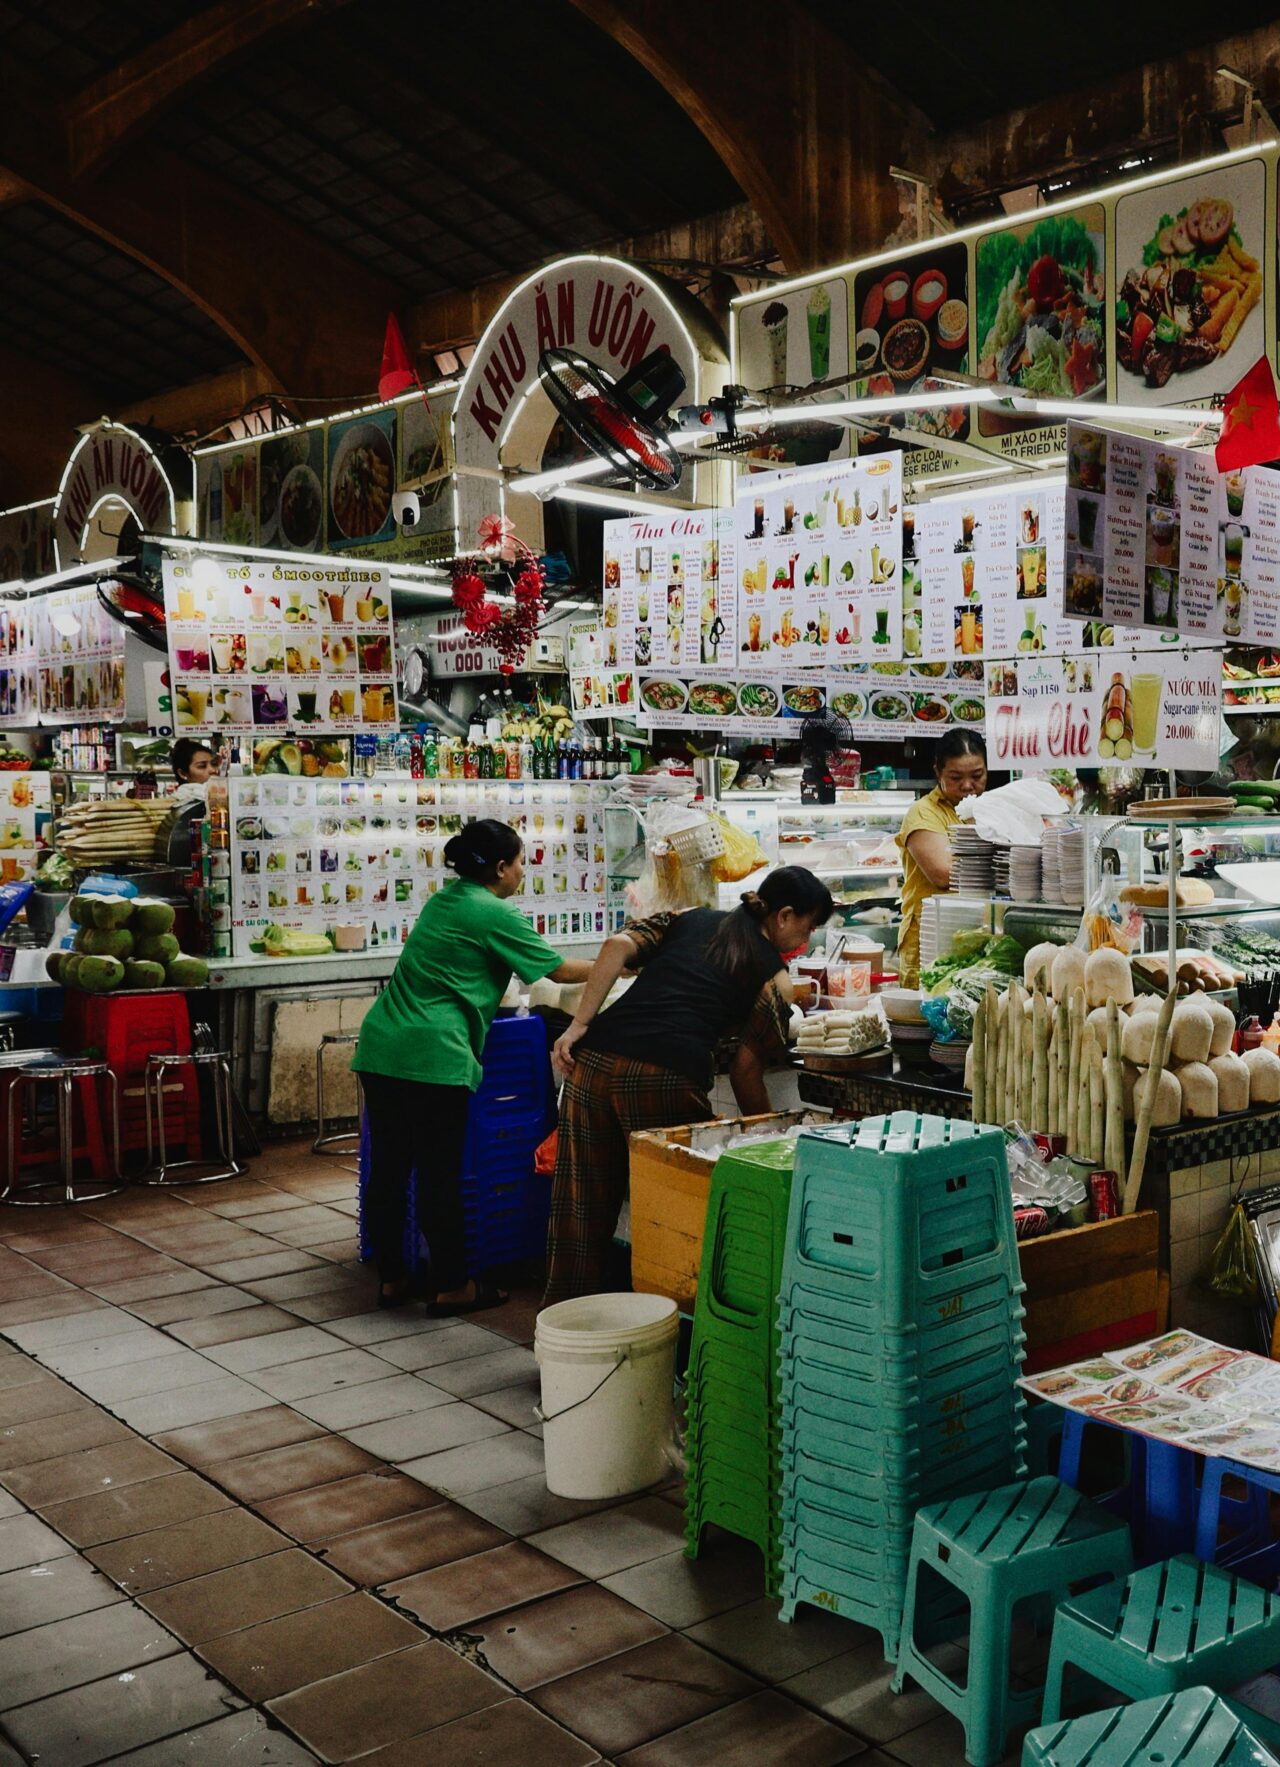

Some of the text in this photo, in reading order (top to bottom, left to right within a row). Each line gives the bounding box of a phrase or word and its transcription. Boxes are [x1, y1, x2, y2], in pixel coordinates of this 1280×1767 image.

[469, 280, 672, 443] KHU ĂN UỐN
[1015, 432, 1037, 446] XÀO
[1020, 443, 1050, 458] FRIED
[904, 452, 922, 466] CÁC
[921, 462, 940, 474] RICE
[64, 464, 92, 544] KHU
[92, 437, 114, 490] ĂN
[630, 521, 664, 540] Thu
[227, 566, 250, 580] TỐ
[272, 570, 382, 582] SMOOTHIES
[572, 624, 598, 634] SINH
[1022, 684, 1060, 698] Sạp 1150
[1167, 677, 1217, 697] NƯỚC MÍA
[1164, 701, 1200, 717] Sugar-cane
[996, 702, 1092, 760] Thu Chè
[1166, 724, 1196, 740] 20.000
